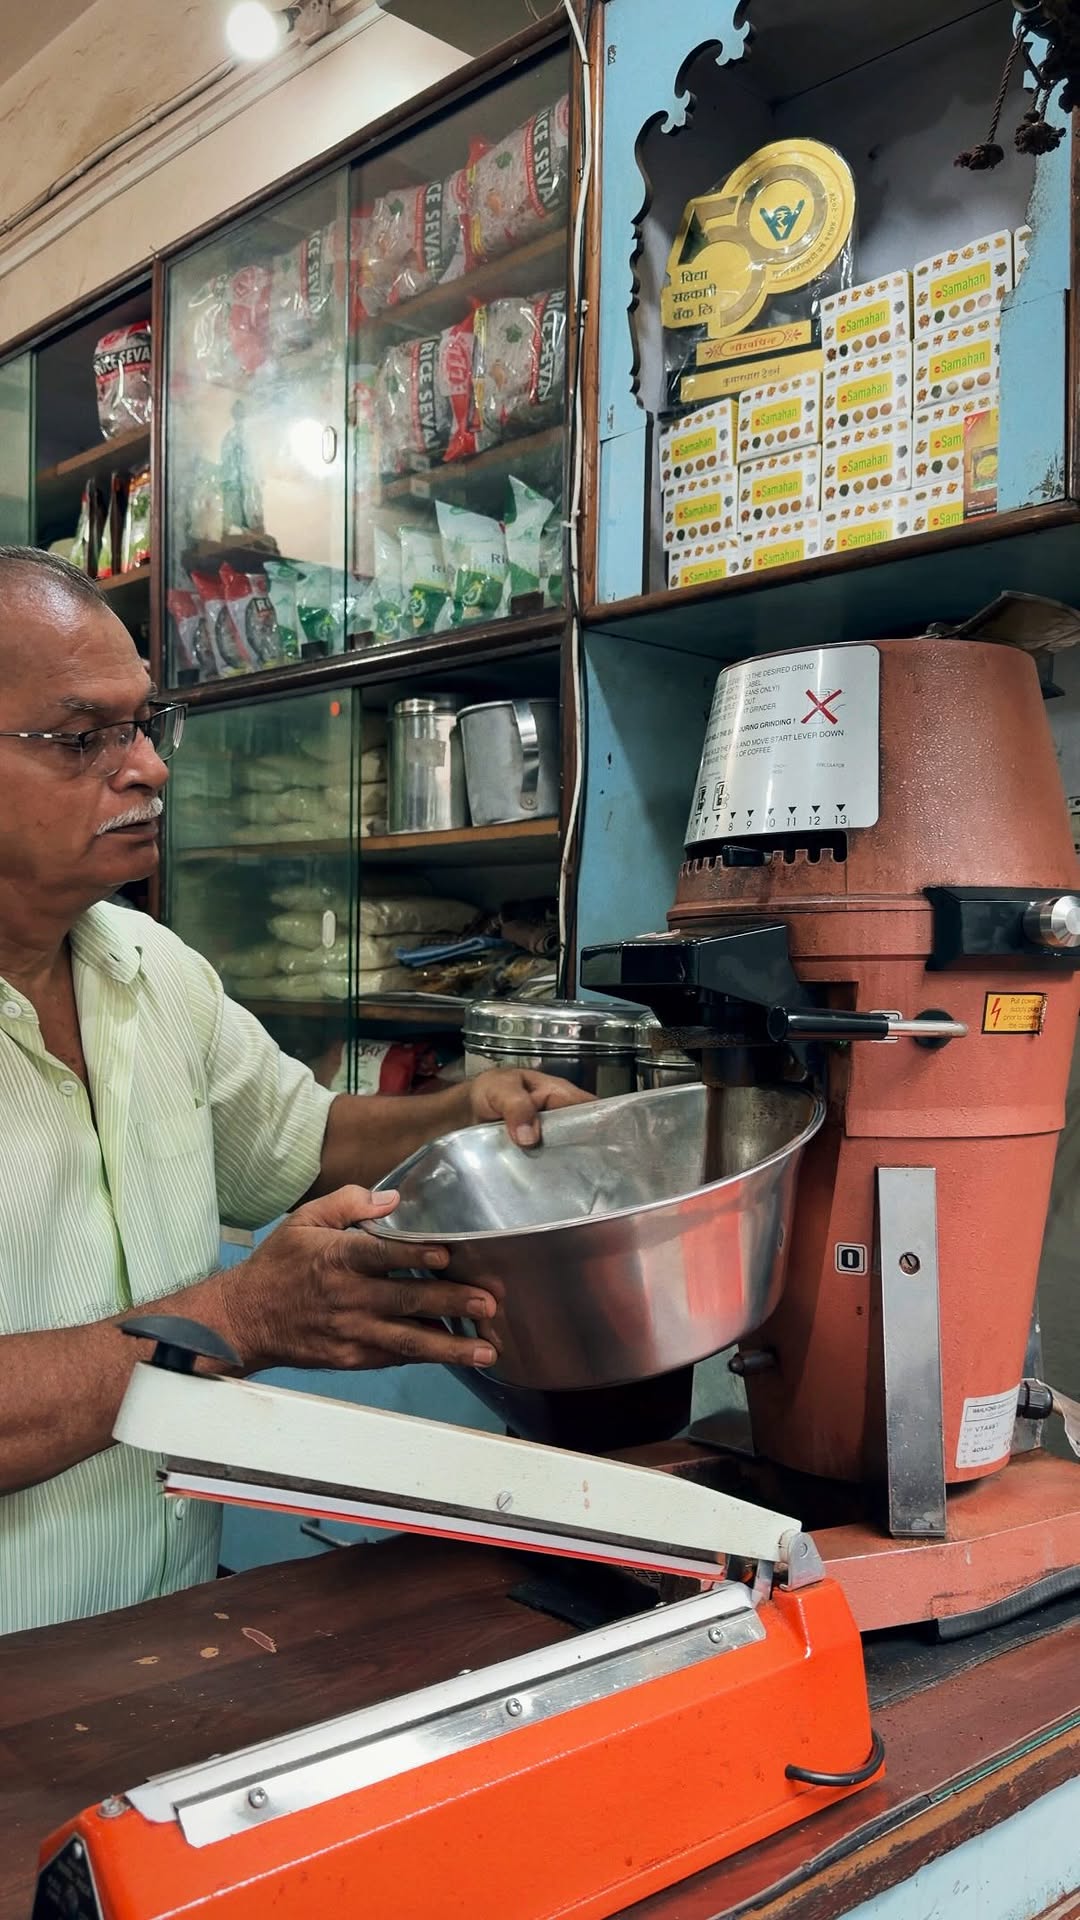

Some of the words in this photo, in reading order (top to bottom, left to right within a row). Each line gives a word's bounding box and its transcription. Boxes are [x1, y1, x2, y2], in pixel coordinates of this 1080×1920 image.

[942, 273, 986, 298] Samahan
[846, 311, 886, 332] Samahan
[419, 341, 436, 384] RICE
[941, 352, 985, 373] Samahan
[847, 382, 888, 402] Samahan
[760, 407, 797, 426] Samahan
[680, 436, 712, 456] Samahan
[847, 453, 888, 473] Samahan
[761, 480, 798, 498] Samahan
[683, 502, 718, 518] Samahan
[847, 528, 888, 547] Samahan
[763, 548, 800, 566] Samahan
[688, 567, 722, 584] Samahan
[762, 666, 791, 677] DESIRED
[760, 718, 792, 729] GRINDING
[771, 734, 792, 744] START
[794, 732, 818, 740] LEVER
[820, 730, 845, 738] DOWN
[714, 825, 719, 833] 7
[728, 823, 734, 831] 8
[746, 820, 752, 830] 9
[786, 817, 797, 827] 11
[809, 816, 821, 826] 12
[834, 815, 847, 824] 13
